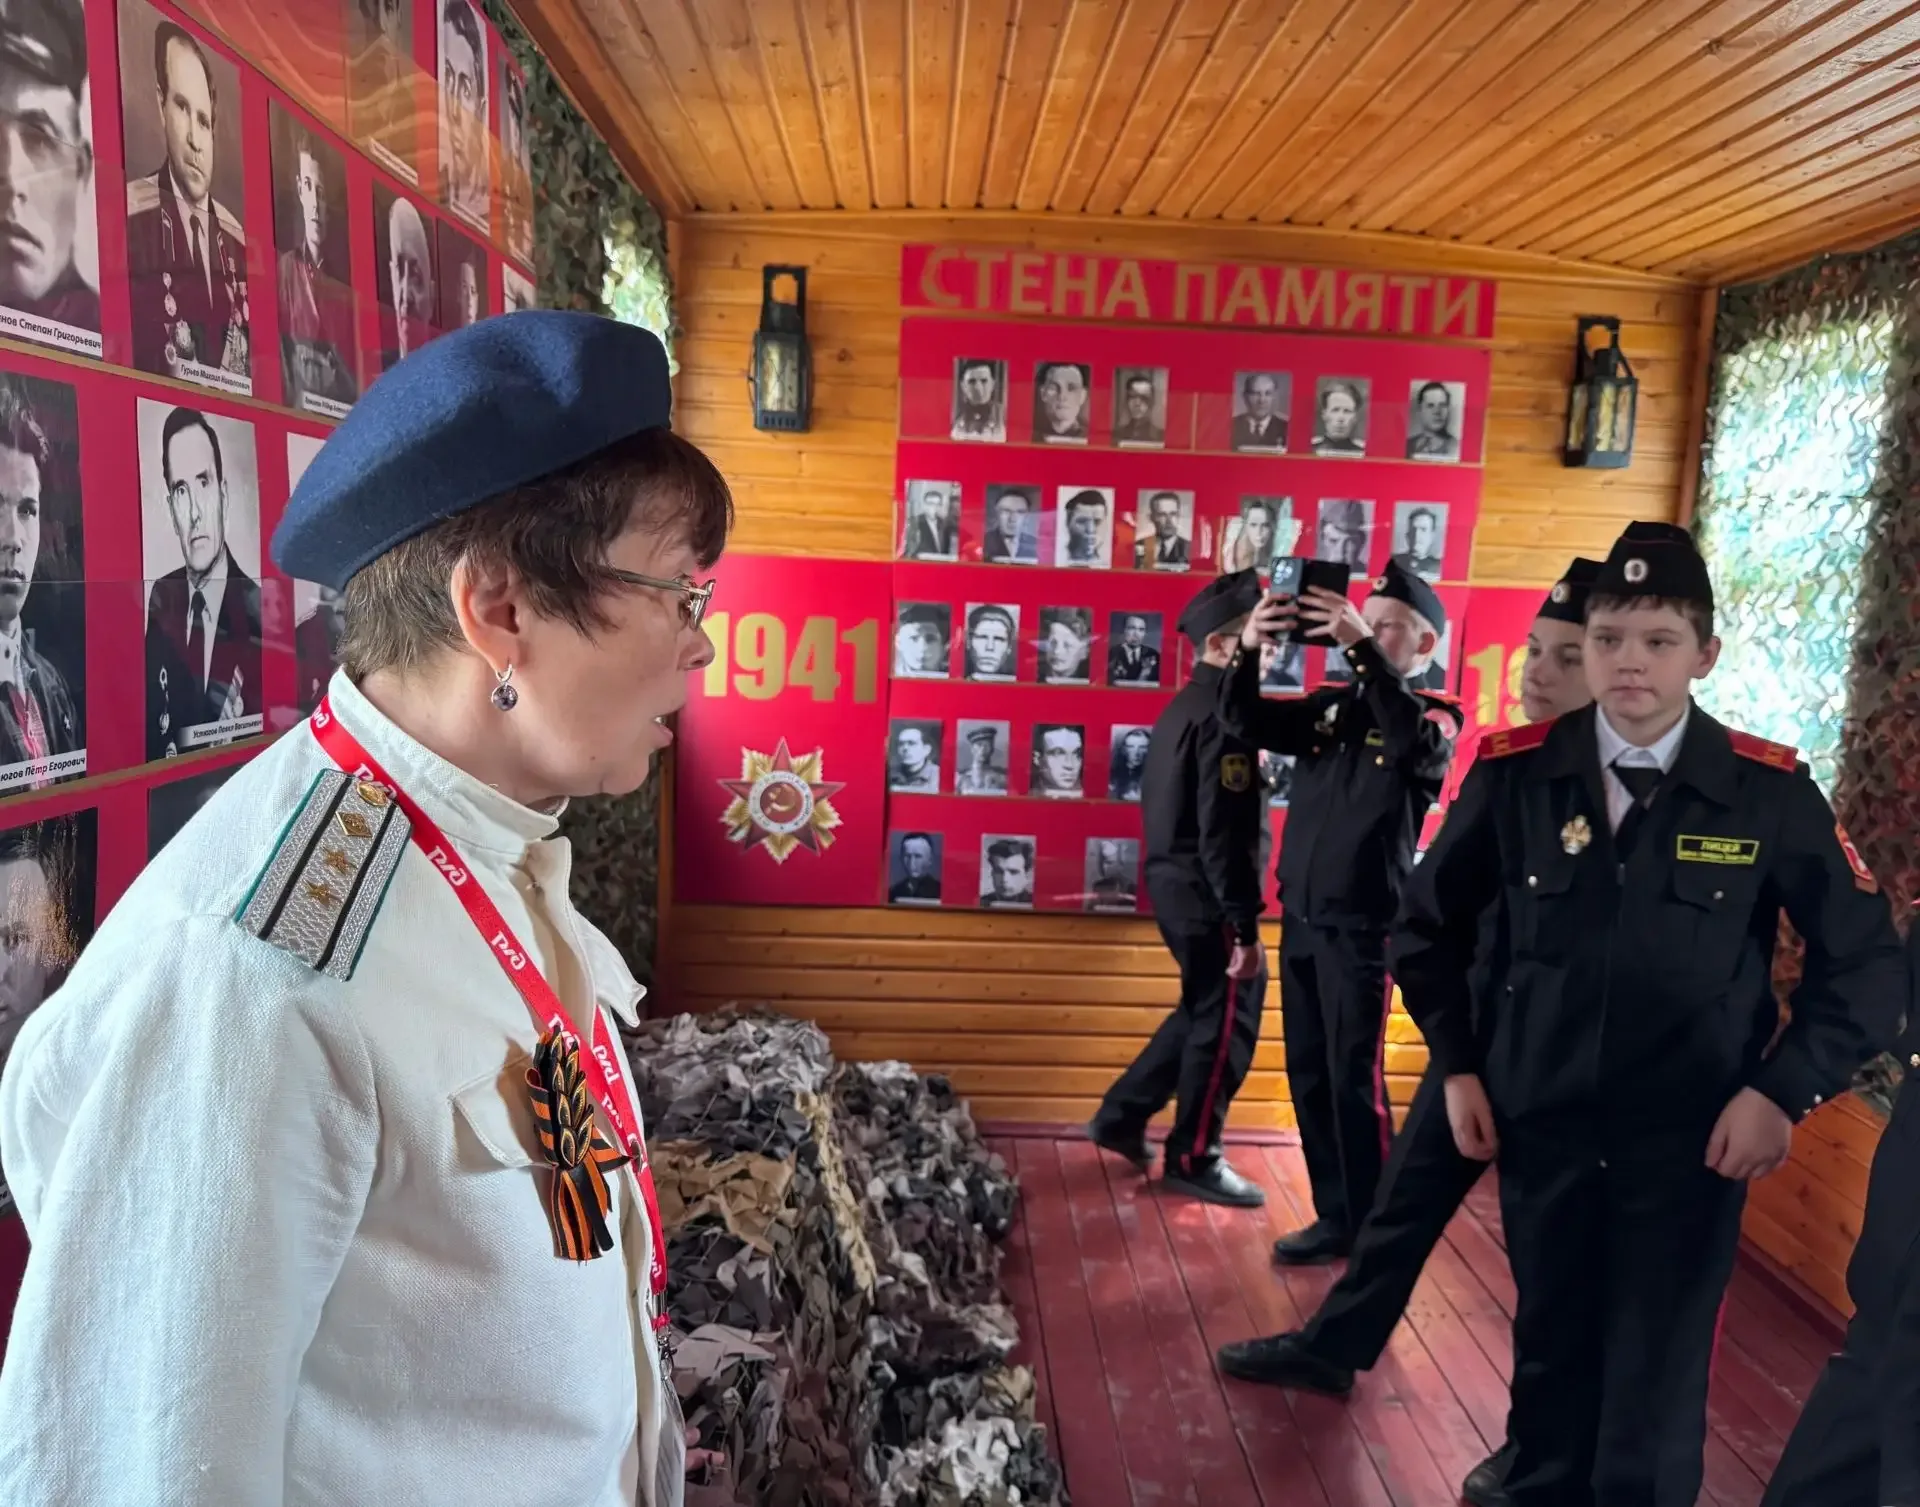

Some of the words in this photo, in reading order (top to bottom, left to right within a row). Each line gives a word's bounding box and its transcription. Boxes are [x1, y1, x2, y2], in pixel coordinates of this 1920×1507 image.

[921, 247, 1149, 319] СТЕНА
[1173, 264, 1479, 335] ПАМЯТИ
[0, 315, 17, 327] нов
[19, 318, 53, 336] Степан
[54, 327, 101, 349] Григорьевич
[701, 611, 880, 705] 1941
[25, 764, 48, 776] Пётр
[49, 757, 86, 771] Егорович
